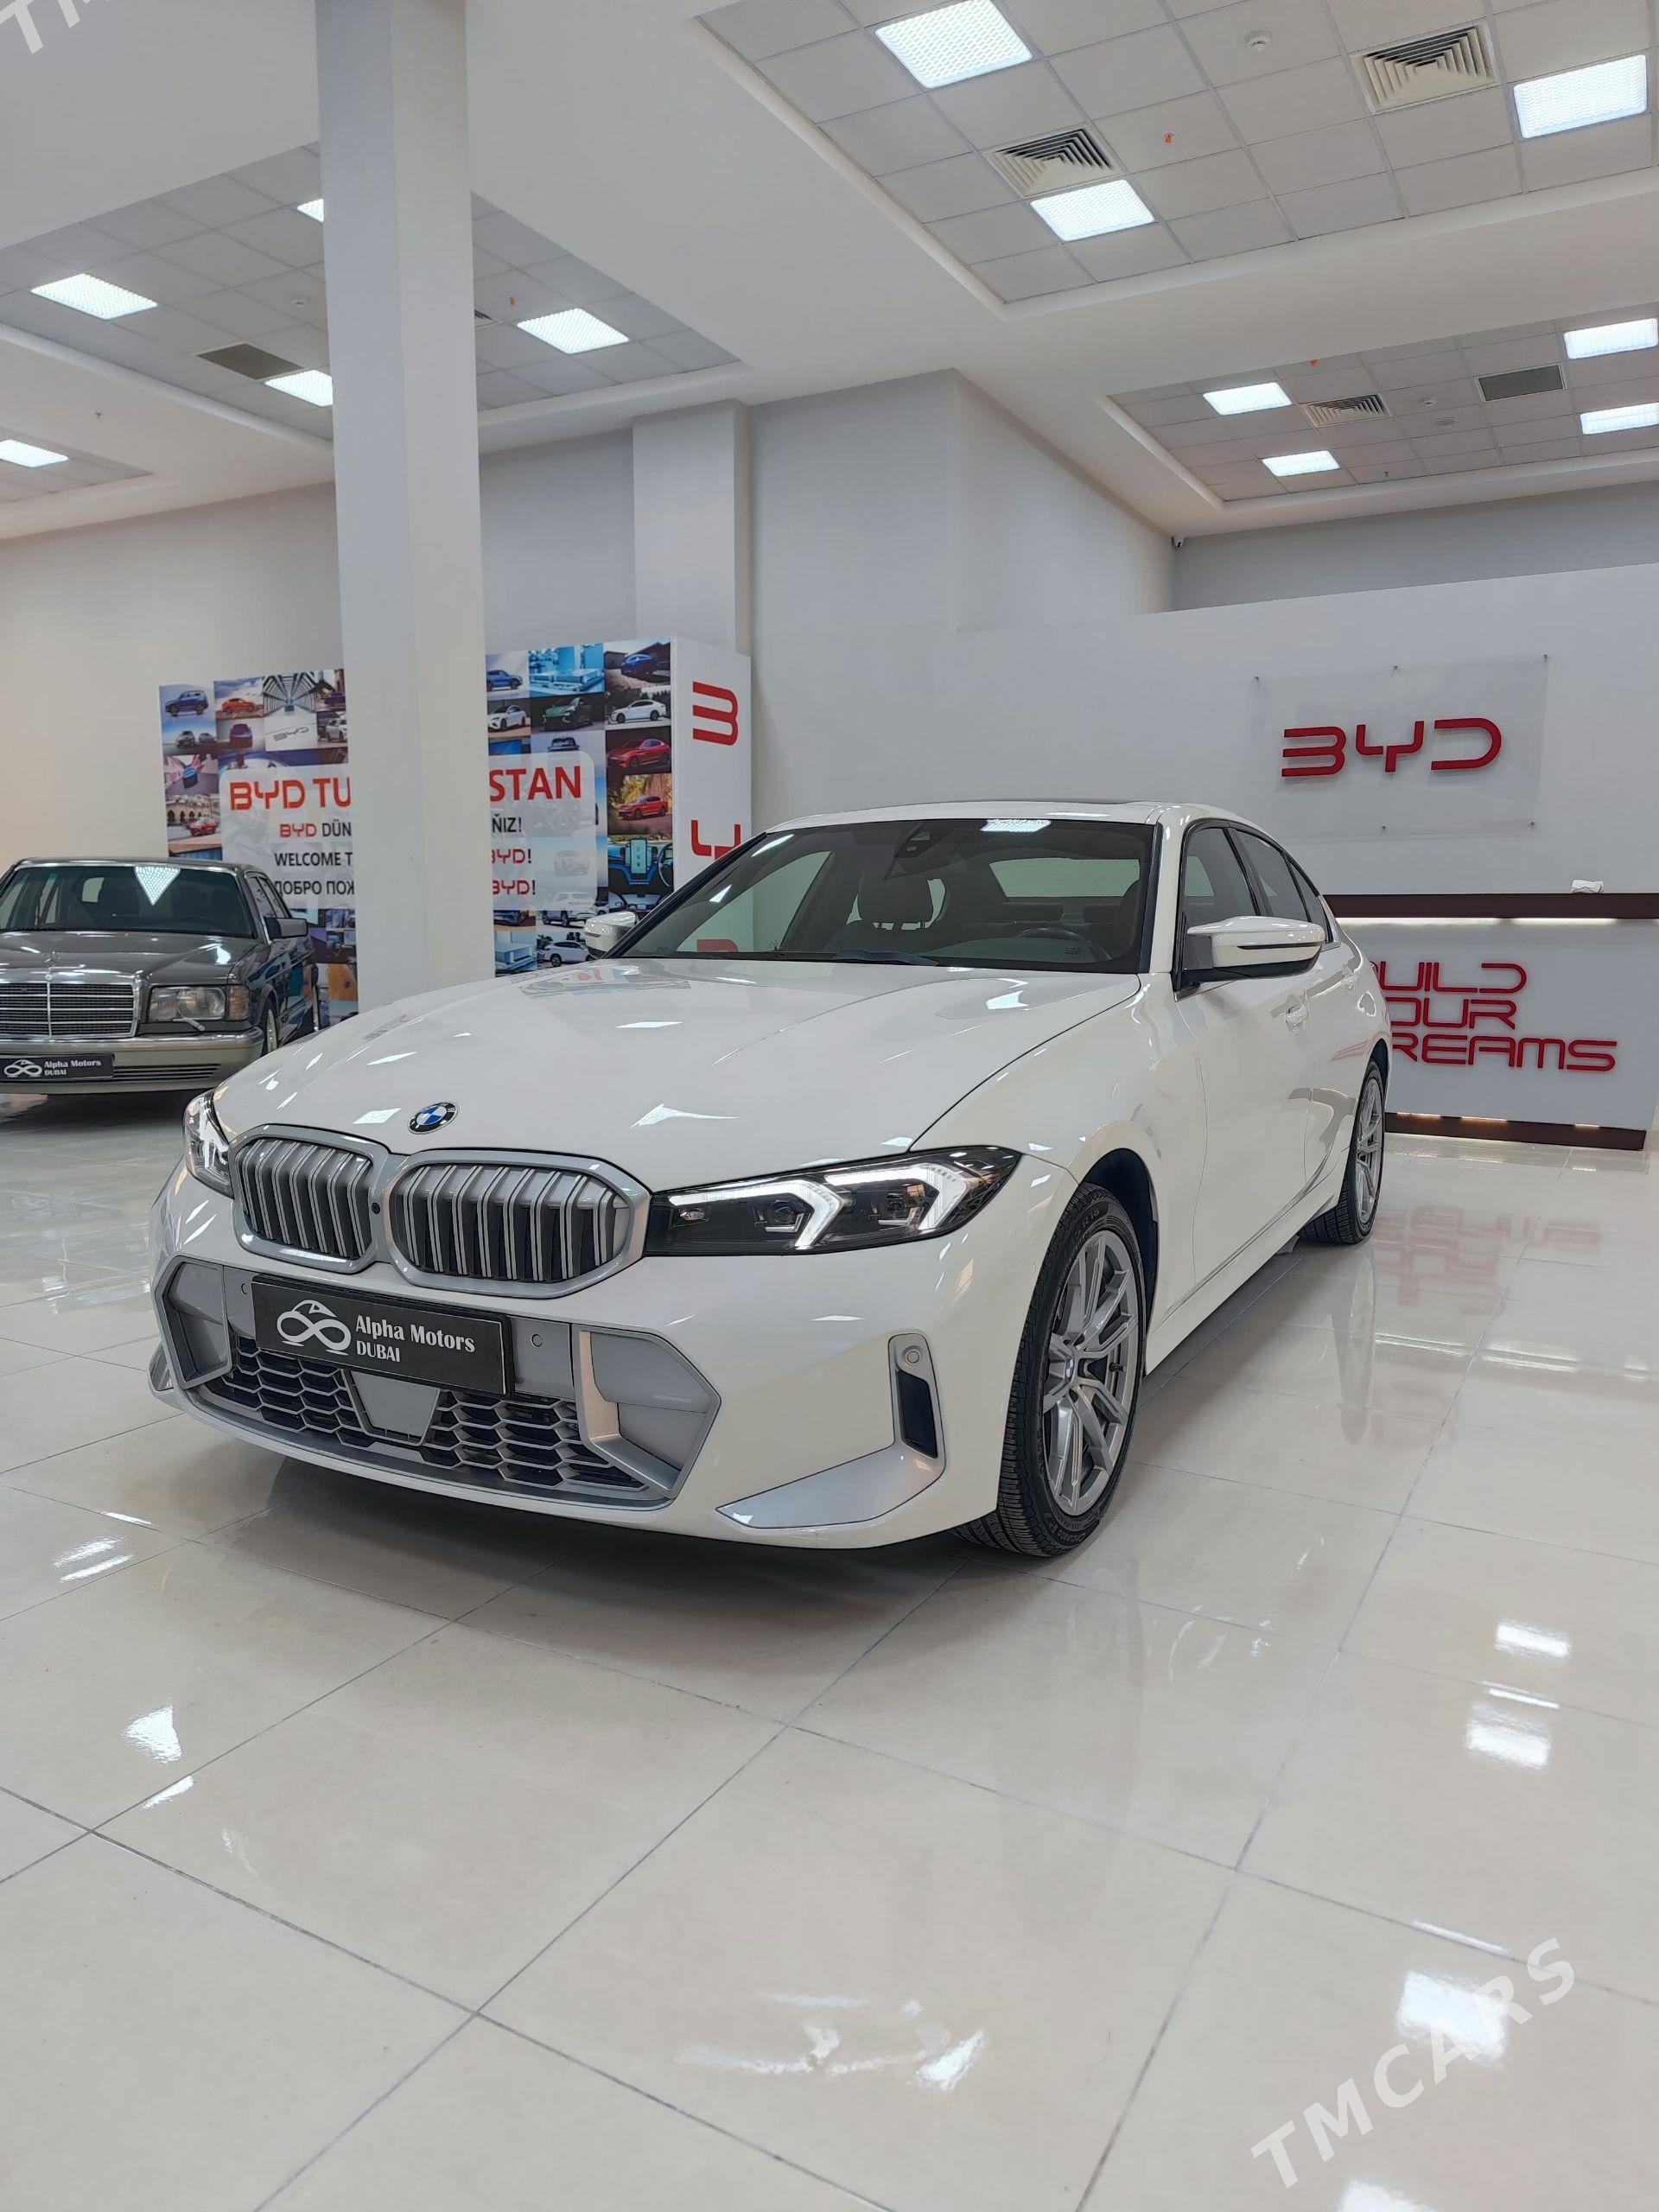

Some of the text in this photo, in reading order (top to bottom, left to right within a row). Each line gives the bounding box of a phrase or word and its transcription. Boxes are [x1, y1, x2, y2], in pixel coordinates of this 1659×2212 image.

[1281, 717, 1502, 778] BYD
[230, 779, 306, 810] BYD
[489, 766, 581, 802] STAN
[280, 823, 317, 837] BYD
[322, 818, 352, 836] DÜN
[691, 682, 741, 953] BY
[275, 852, 341, 866] WELCOME
[492, 849, 531, 863] YD!
[1370, 961, 1527, 994] UILD
[44, 1059, 102, 1069] Alpha Motors
[356, 1315, 475, 1353] Alpha Motors
[356, 1340, 401, 1363] DUBAI
